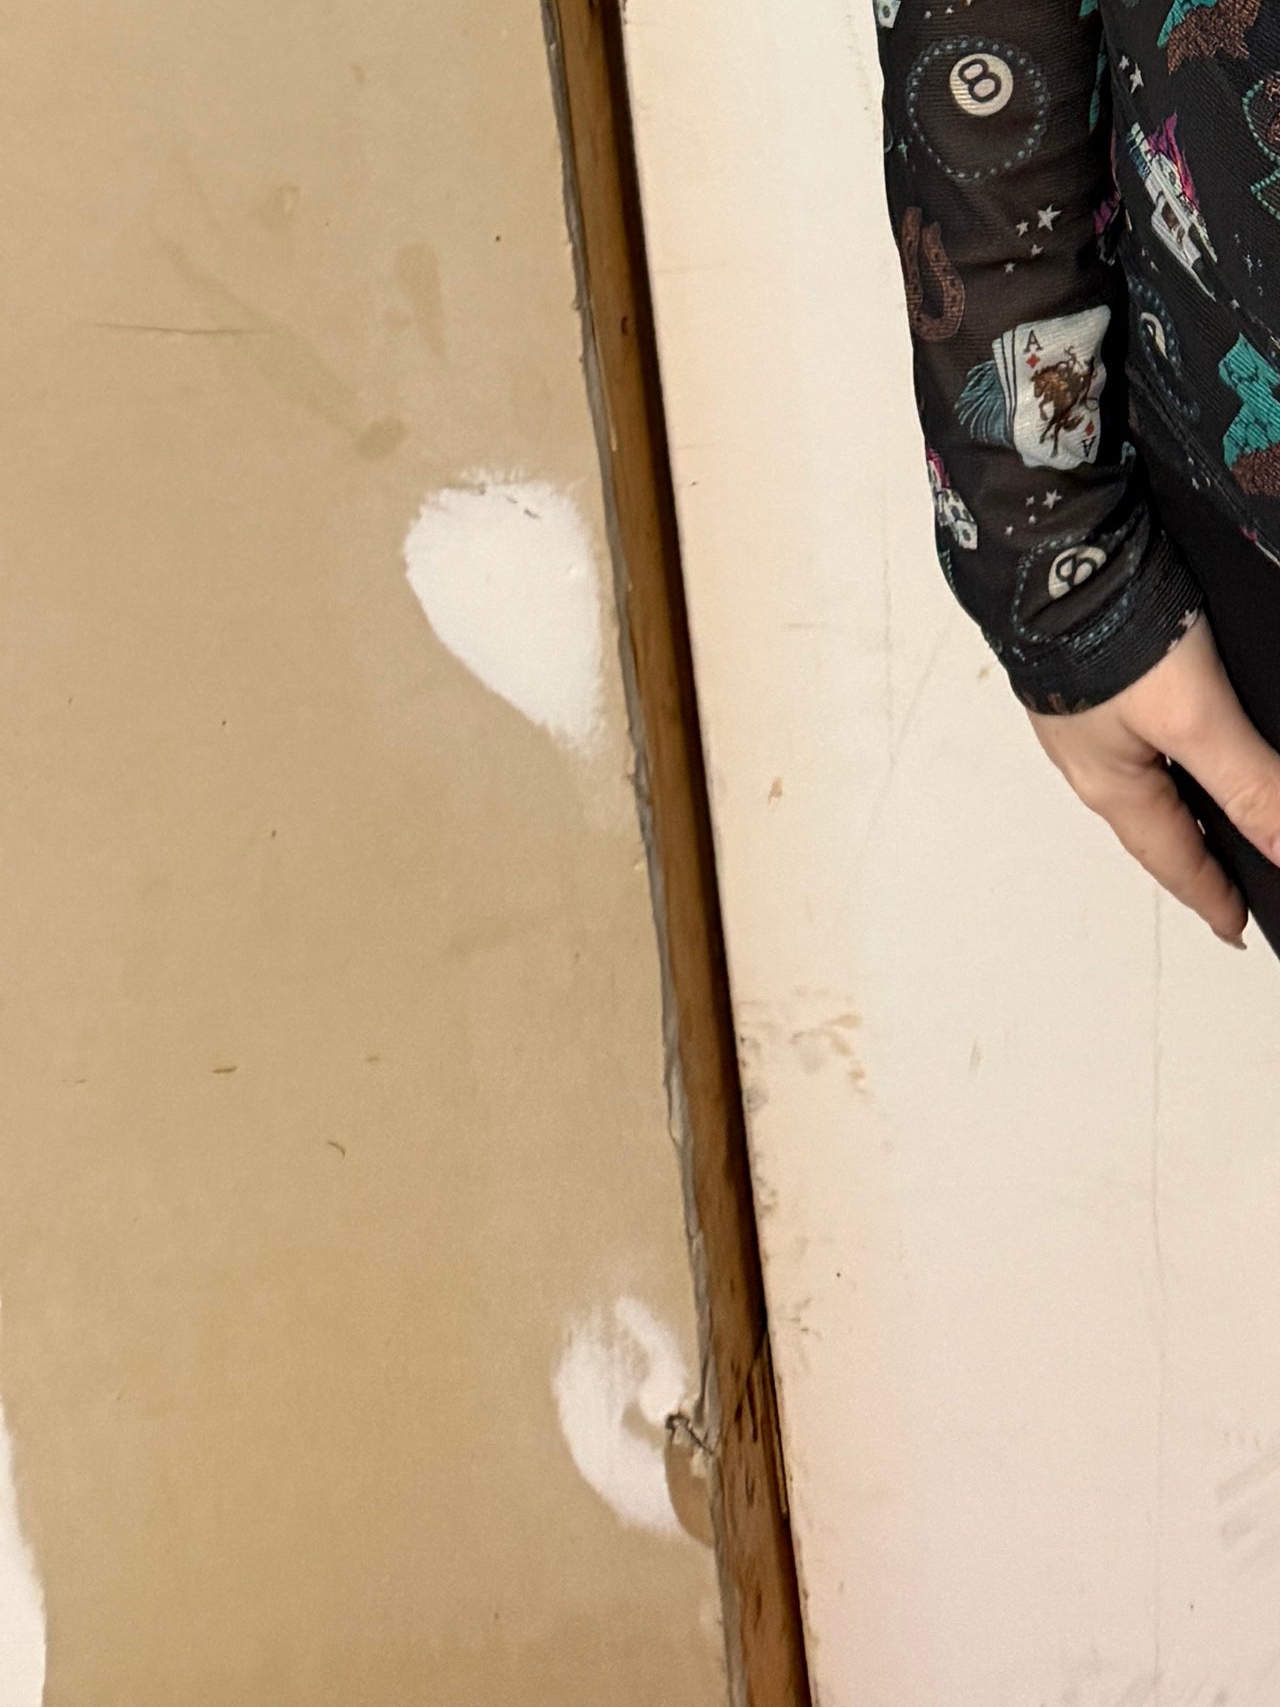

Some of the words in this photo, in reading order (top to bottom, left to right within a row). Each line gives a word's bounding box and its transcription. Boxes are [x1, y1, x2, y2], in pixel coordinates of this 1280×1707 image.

[958, 59, 1001, 103] 8
[1023, 330, 1043, 353] A
[1055, 552, 1097, 587] 8
